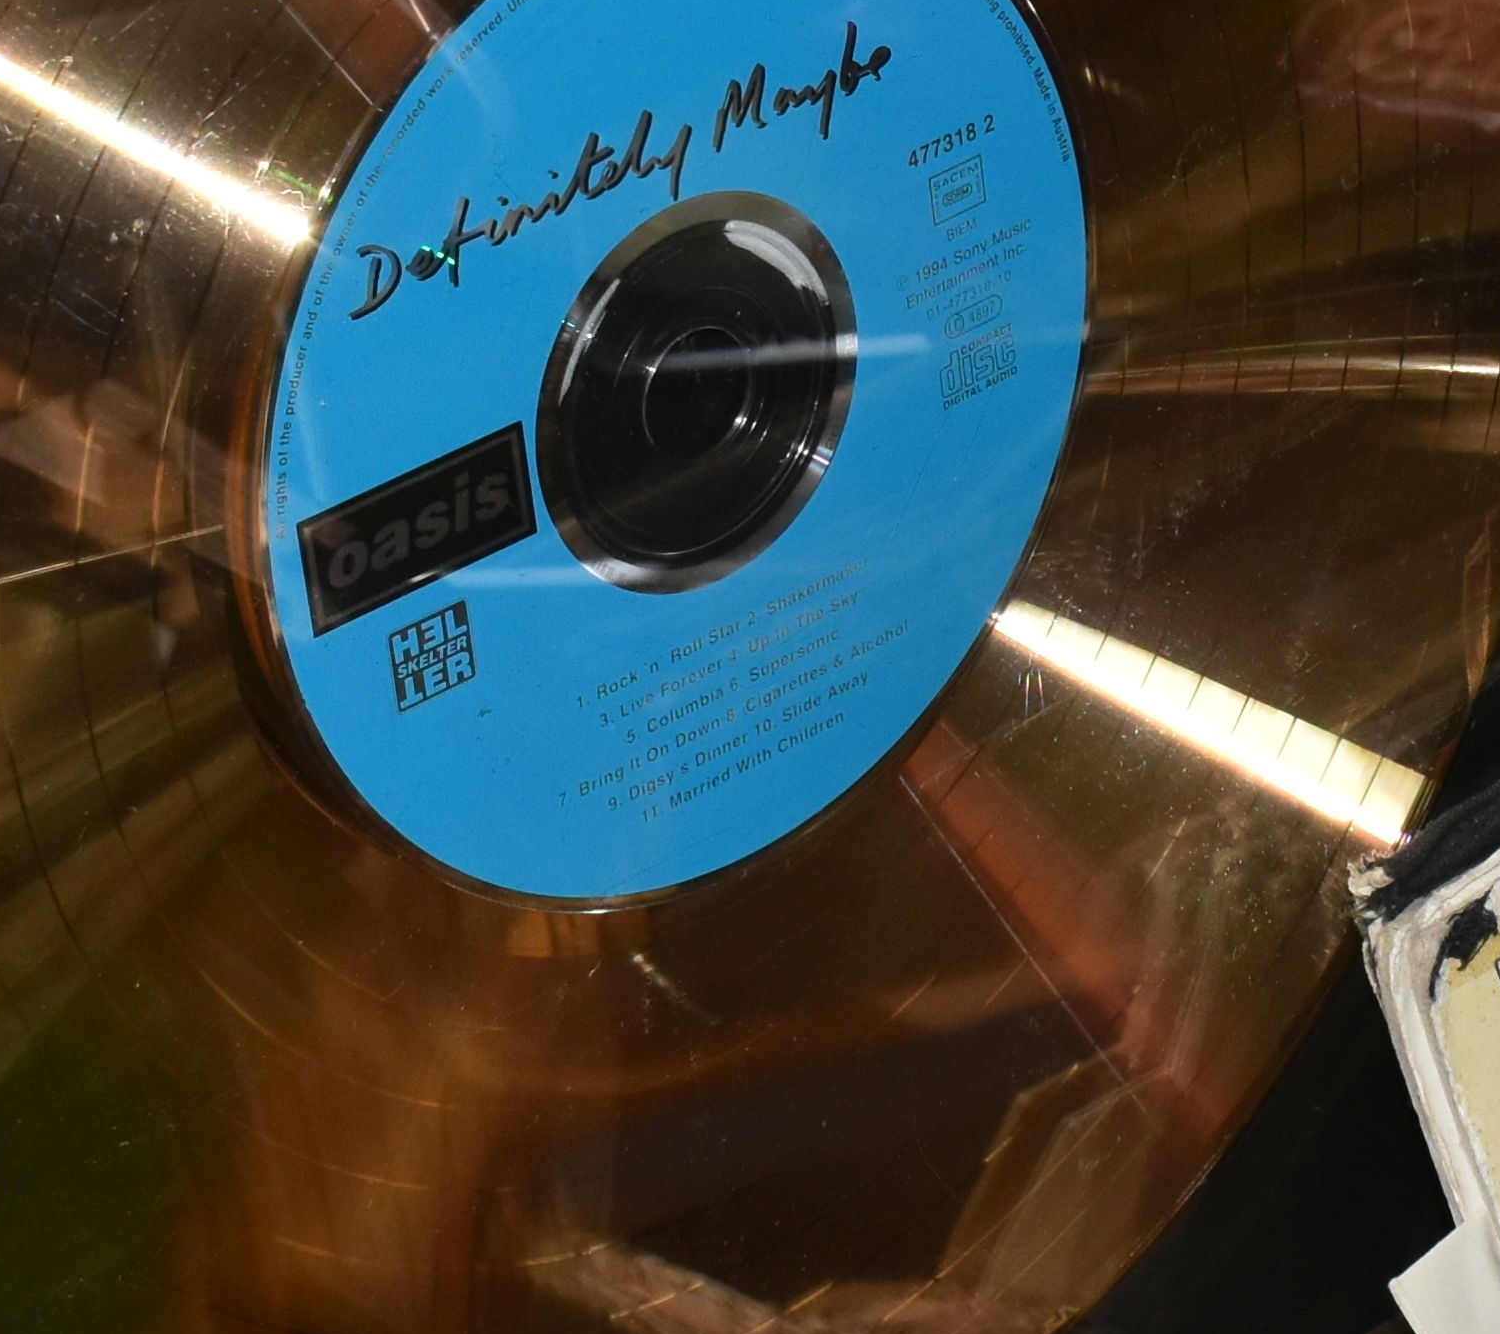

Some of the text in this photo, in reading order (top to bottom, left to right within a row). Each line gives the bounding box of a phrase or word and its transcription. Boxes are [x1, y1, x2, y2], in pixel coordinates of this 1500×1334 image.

[426, 65, 454, 99] work
[1032, 67, 1051, 102] Made
[1046, 101, 1057, 116] in
[382, 98, 426, 165] recorded
[907, 113, 995, 168] 477318 2
[348, 20, 892, 320] Definitely Maybe
[365, 165, 382, 189] the
[931, 162, 979, 192] SACEM
[356, 190, 368, 207] of
[332, 214, 357, 257] owner
[914, 218, 1033, 285] 1994 Sony Music
[946, 217, 978, 242] BIEM
[313, 288, 325, 307] of
[321, 261, 336, 291] the
[905, 254, 1000, 310] Entertainment
[303, 310, 318, 340] and
[960, 322, 1013, 355] COMPACT
[286, 344, 308, 416] producer
[939, 334, 1017, 399] disc
[942, 365, 1018, 411] DIGITAL AUDIO
[281, 421, 292, 447] the
[278, 451, 289, 467] of
[277, 470, 288, 515] rights
[328, 471, 510, 589] oasis
[576, 694, 590, 709] 1.
[595, 672, 639, 700] Rock
[669, 637, 703, 664] Roll
[707, 620, 741, 645] Star
[765, 557, 869, 616] Shakermaker
[396, 636, 468, 679] SKELTER
[600, 713, 614, 729] 3.
[619, 692, 655, 718] Live
[660, 658, 723, 699] Forever
[746, 633, 772, 655] Up
[774, 623, 792, 642] In
[794, 607, 825, 630] The
[828, 589, 860, 614] Sky
[645, 684, 725, 734] Columbia
[749, 628, 840, 682] Supersonic
[557, 792, 572, 807] 7.
[578, 766, 626, 798] Bring
[629, 756, 642, 771] It
[645, 744, 670, 763] On
[675, 717, 721, 747] Down
[743, 663, 829, 713] Cigarettes
[833, 654, 844, 669] &
[850, 619, 910, 661] Alcohol
[607, 796, 622, 812] 9.
[694, 732, 748, 768] Dinner
[754, 718, 776, 736] 10.
[781, 693, 822, 723] Slide
[827, 671, 869, 699] Away
[669, 765, 732, 808] Married
[735, 747, 773, 774] With
[777, 712, 846, 754] Children
